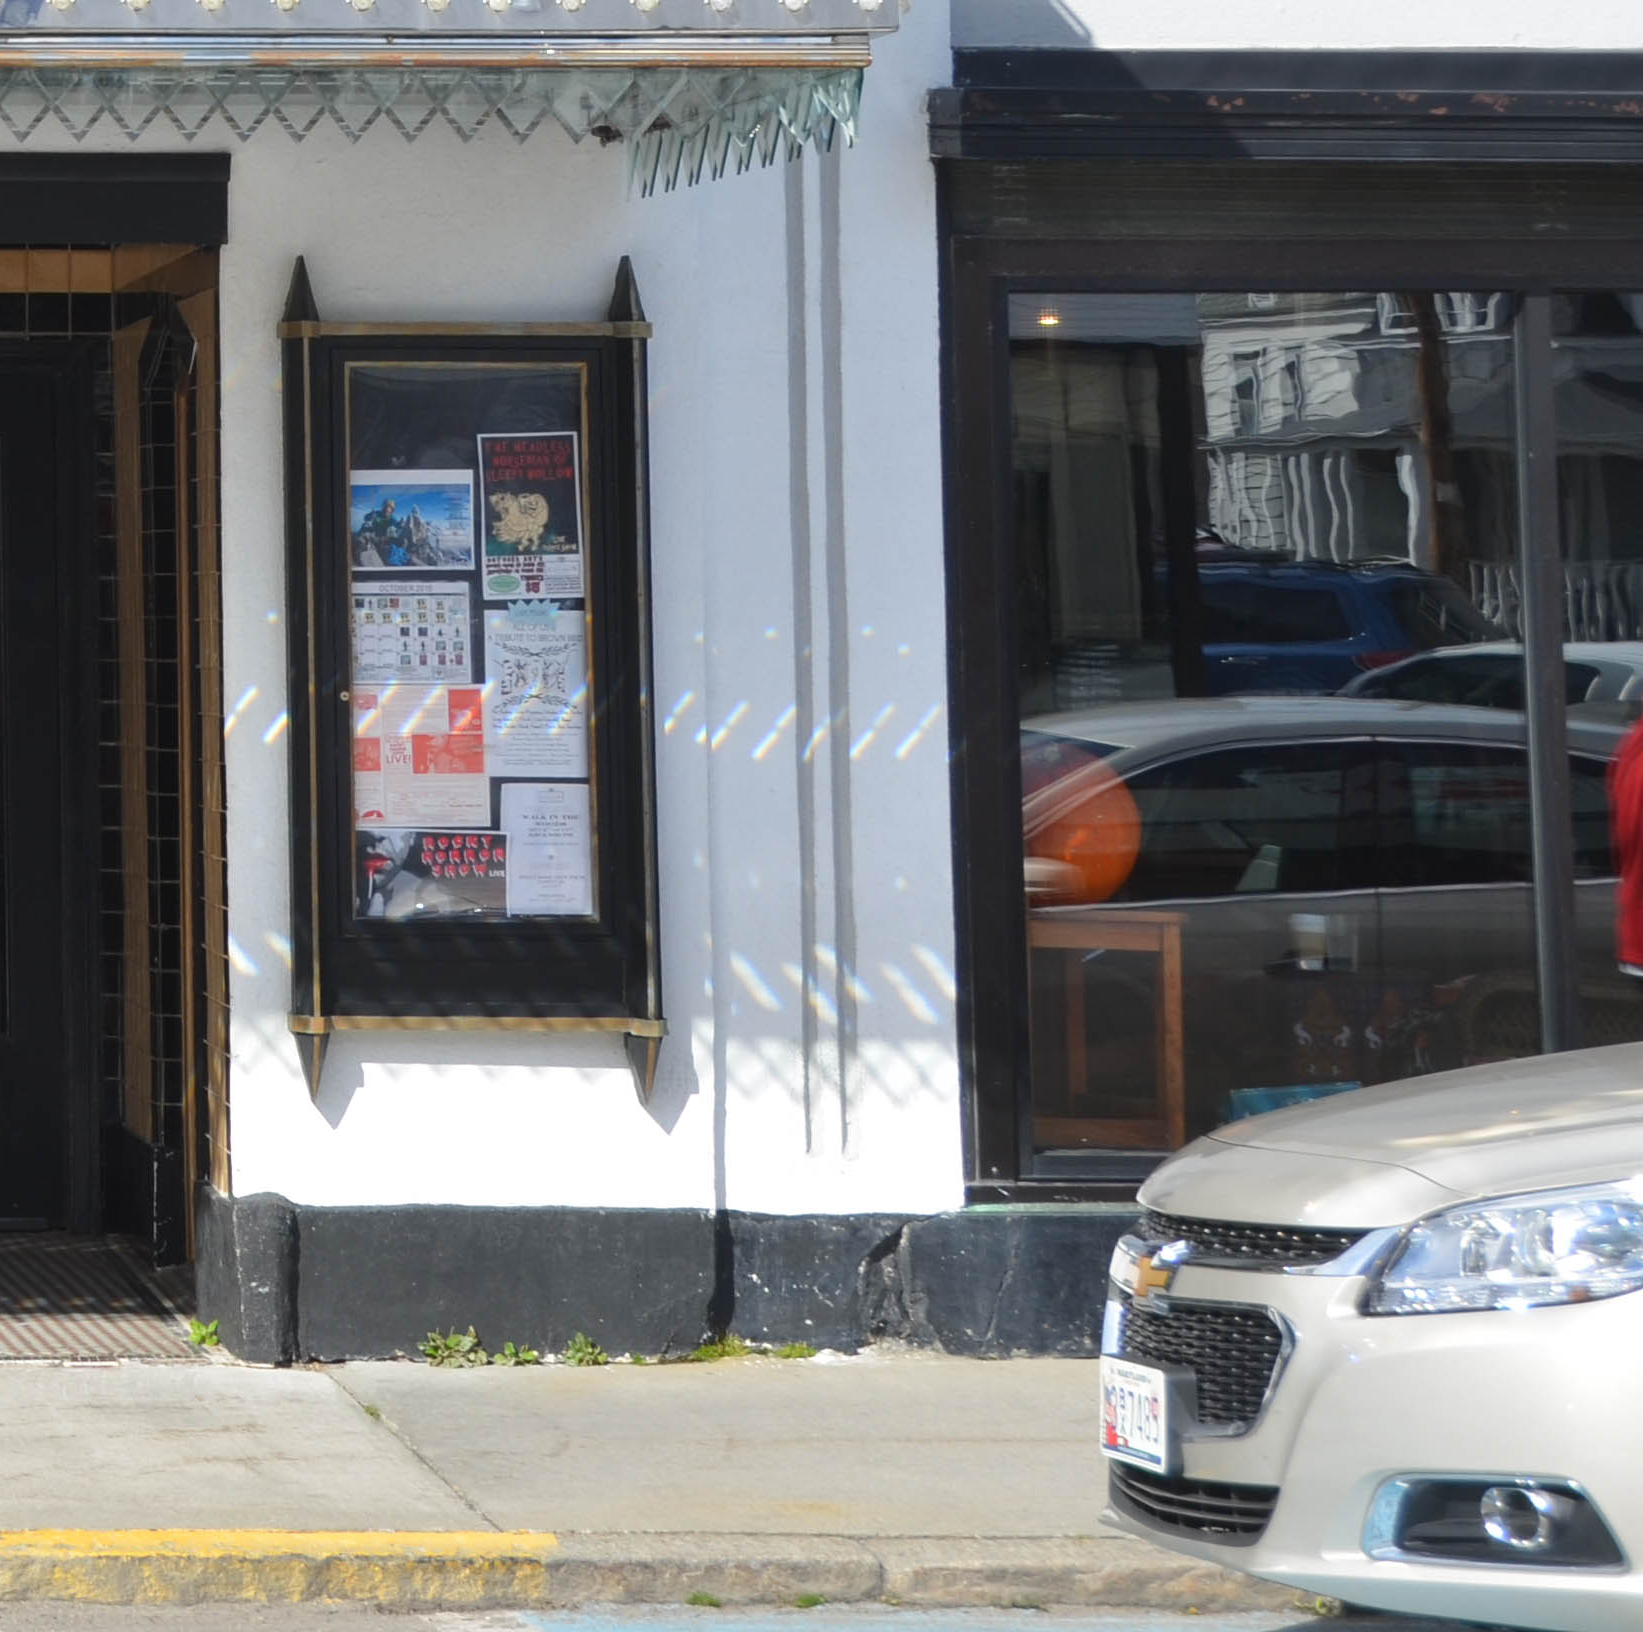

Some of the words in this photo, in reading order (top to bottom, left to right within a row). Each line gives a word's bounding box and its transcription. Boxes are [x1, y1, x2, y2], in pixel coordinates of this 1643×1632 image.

[379, 584, 418, 593] OCTOBER
[422, 835, 492, 850] ROCKY
[421, 847, 506, 864] HORROR
[431, 864, 487, 878] SHOW
[489, 870, 506, 878] LIVE
